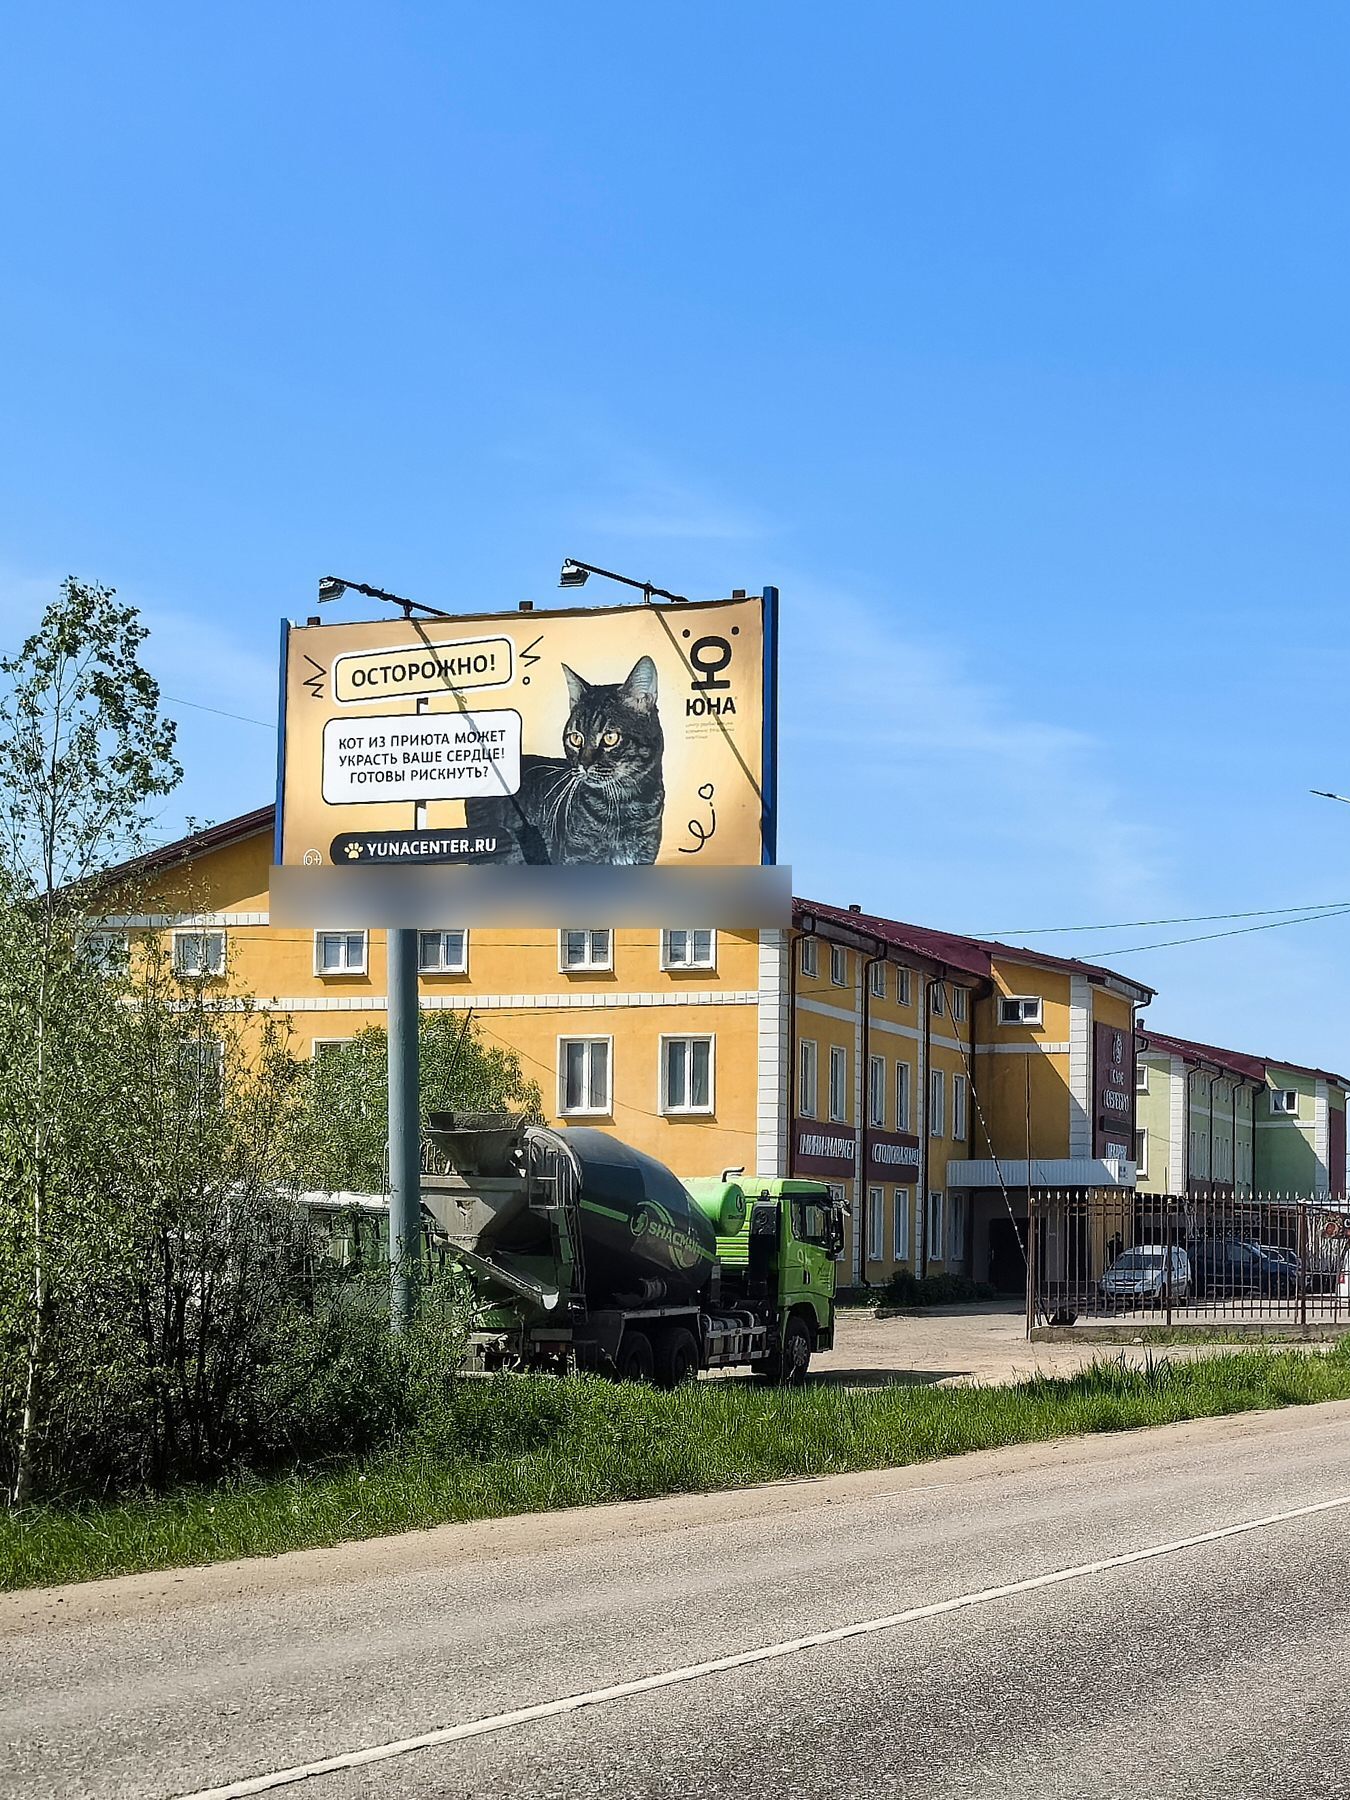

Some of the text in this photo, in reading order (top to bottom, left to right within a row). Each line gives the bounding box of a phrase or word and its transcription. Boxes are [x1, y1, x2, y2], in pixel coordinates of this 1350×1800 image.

[352, 654, 495, 687] ОСТОРОЖНО!
[686, 697, 736, 716] ЮНА
[339, 730, 506, 750] КОТ ИЗ ПРИЮТА МОЖЕТ
[339, 748, 505, 767] УКРАСТЬ ВАШЕ СЕРДЦЕ!
[350, 766, 489, 784] ГОТОВЫ РИСКНУТЬ?
[367, 838, 497, 856] YUNACENTER.RU
